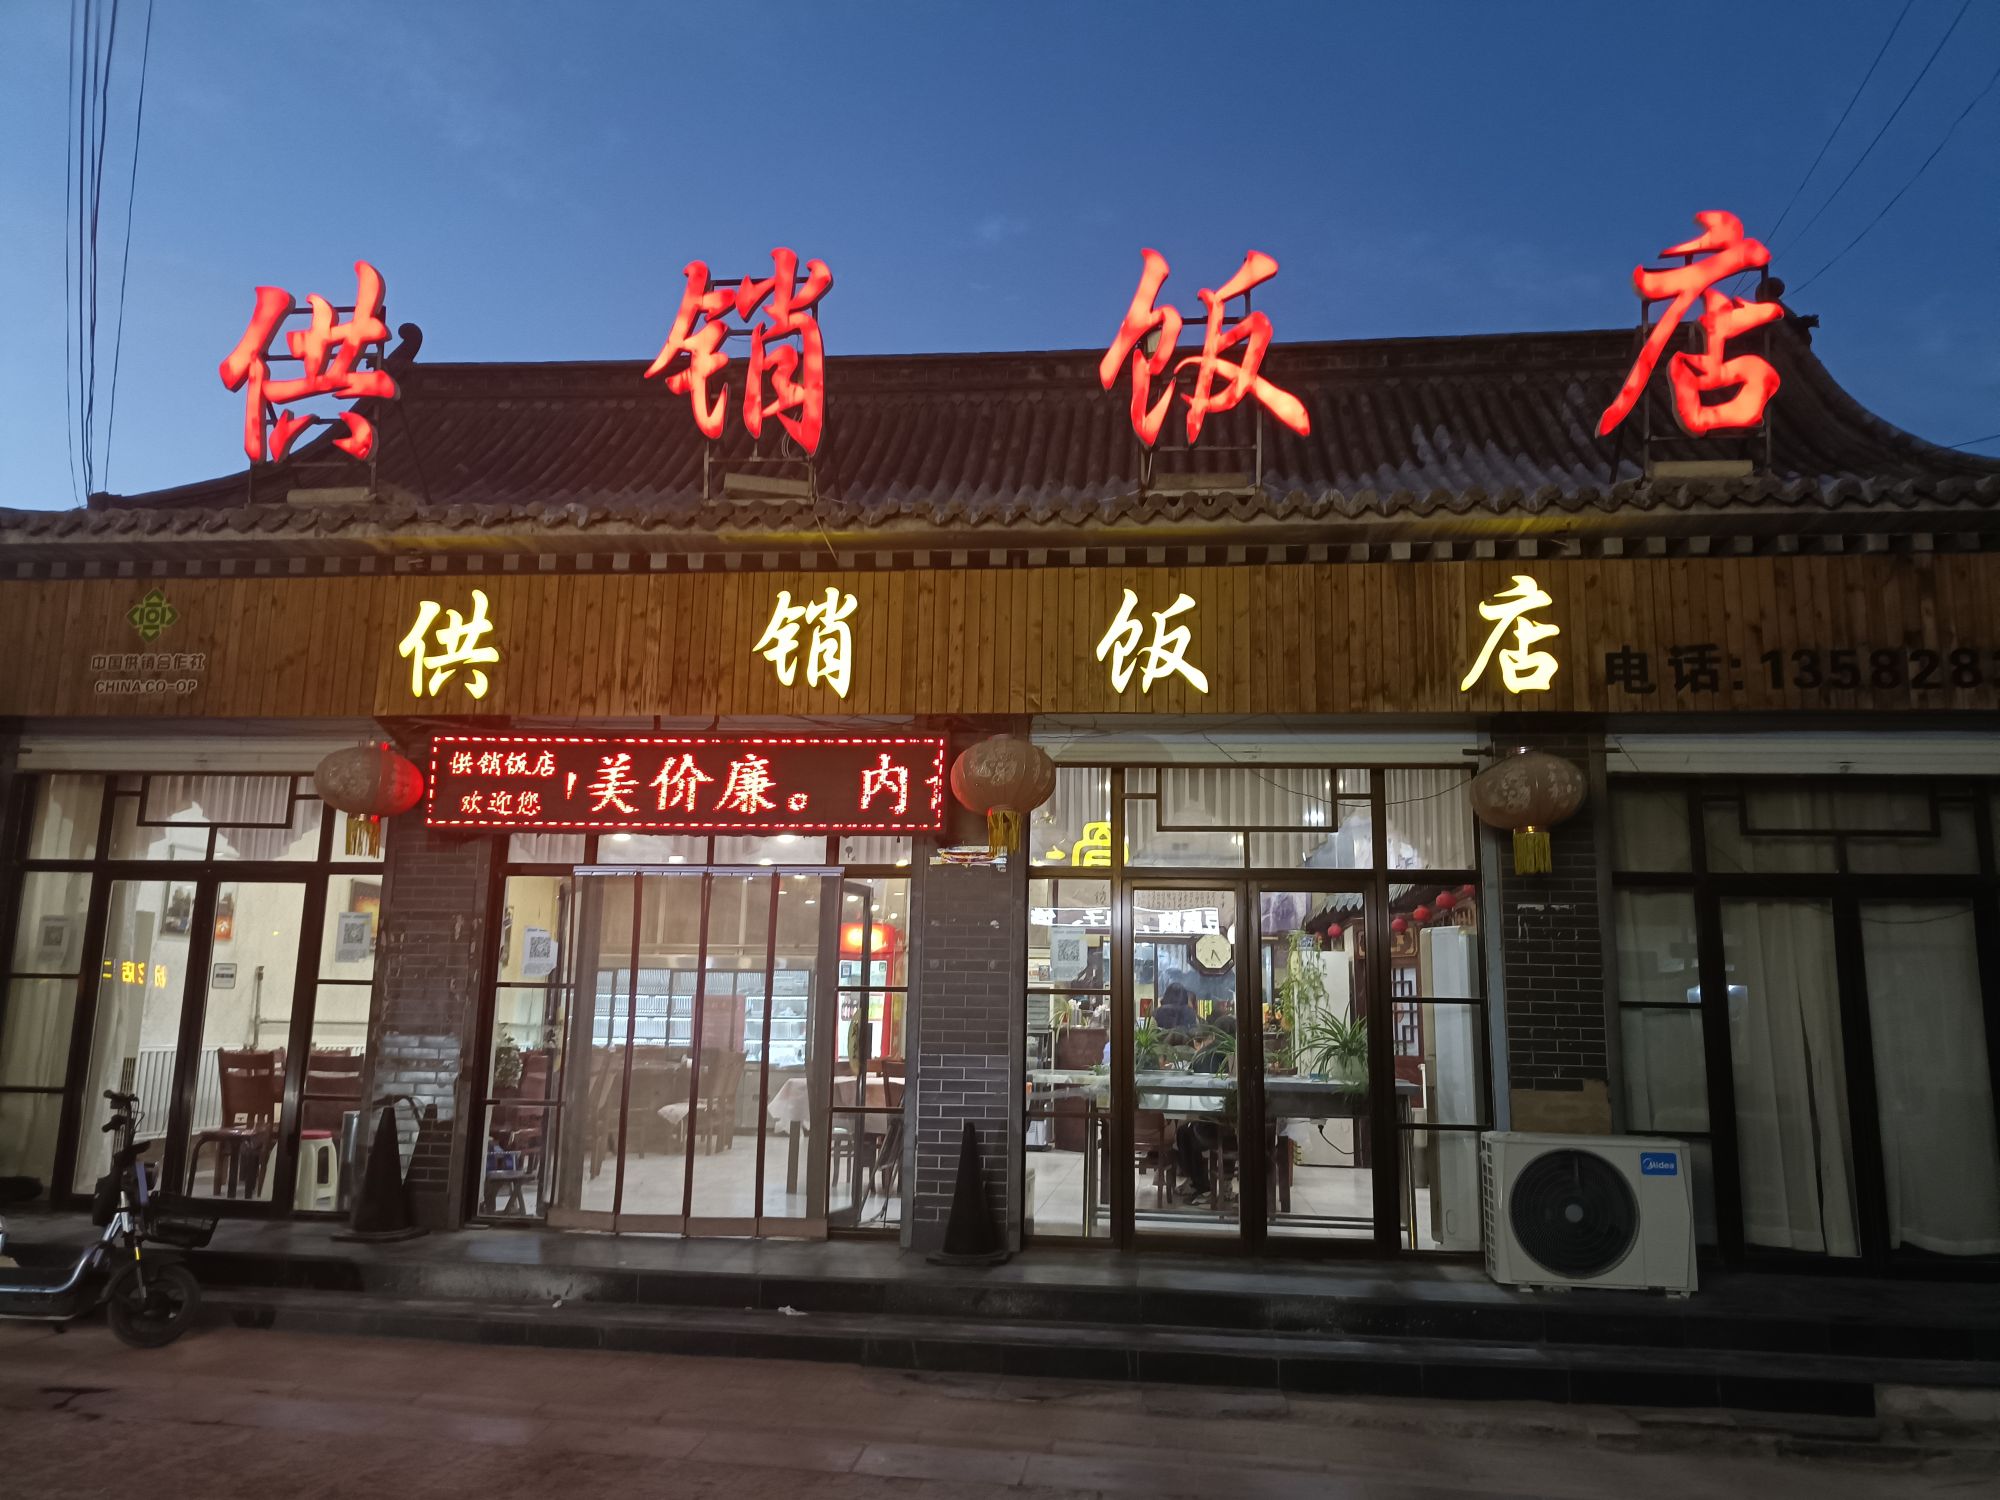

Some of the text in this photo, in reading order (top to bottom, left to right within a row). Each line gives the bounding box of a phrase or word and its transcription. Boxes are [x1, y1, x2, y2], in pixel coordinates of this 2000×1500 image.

[220, 211, 1784, 462] 供销饭店
[398, 575, 1561, 700] 供销饭店
[91, 653, 205, 672] 中国供销合作社
[1605, 642, 2000, 694] 电话:135828
[95, 679, 198, 694] CHINA CO-OP
[449, 750, 556, 776] 供销饭店
[460, 790, 541, 816] 欢迎您
